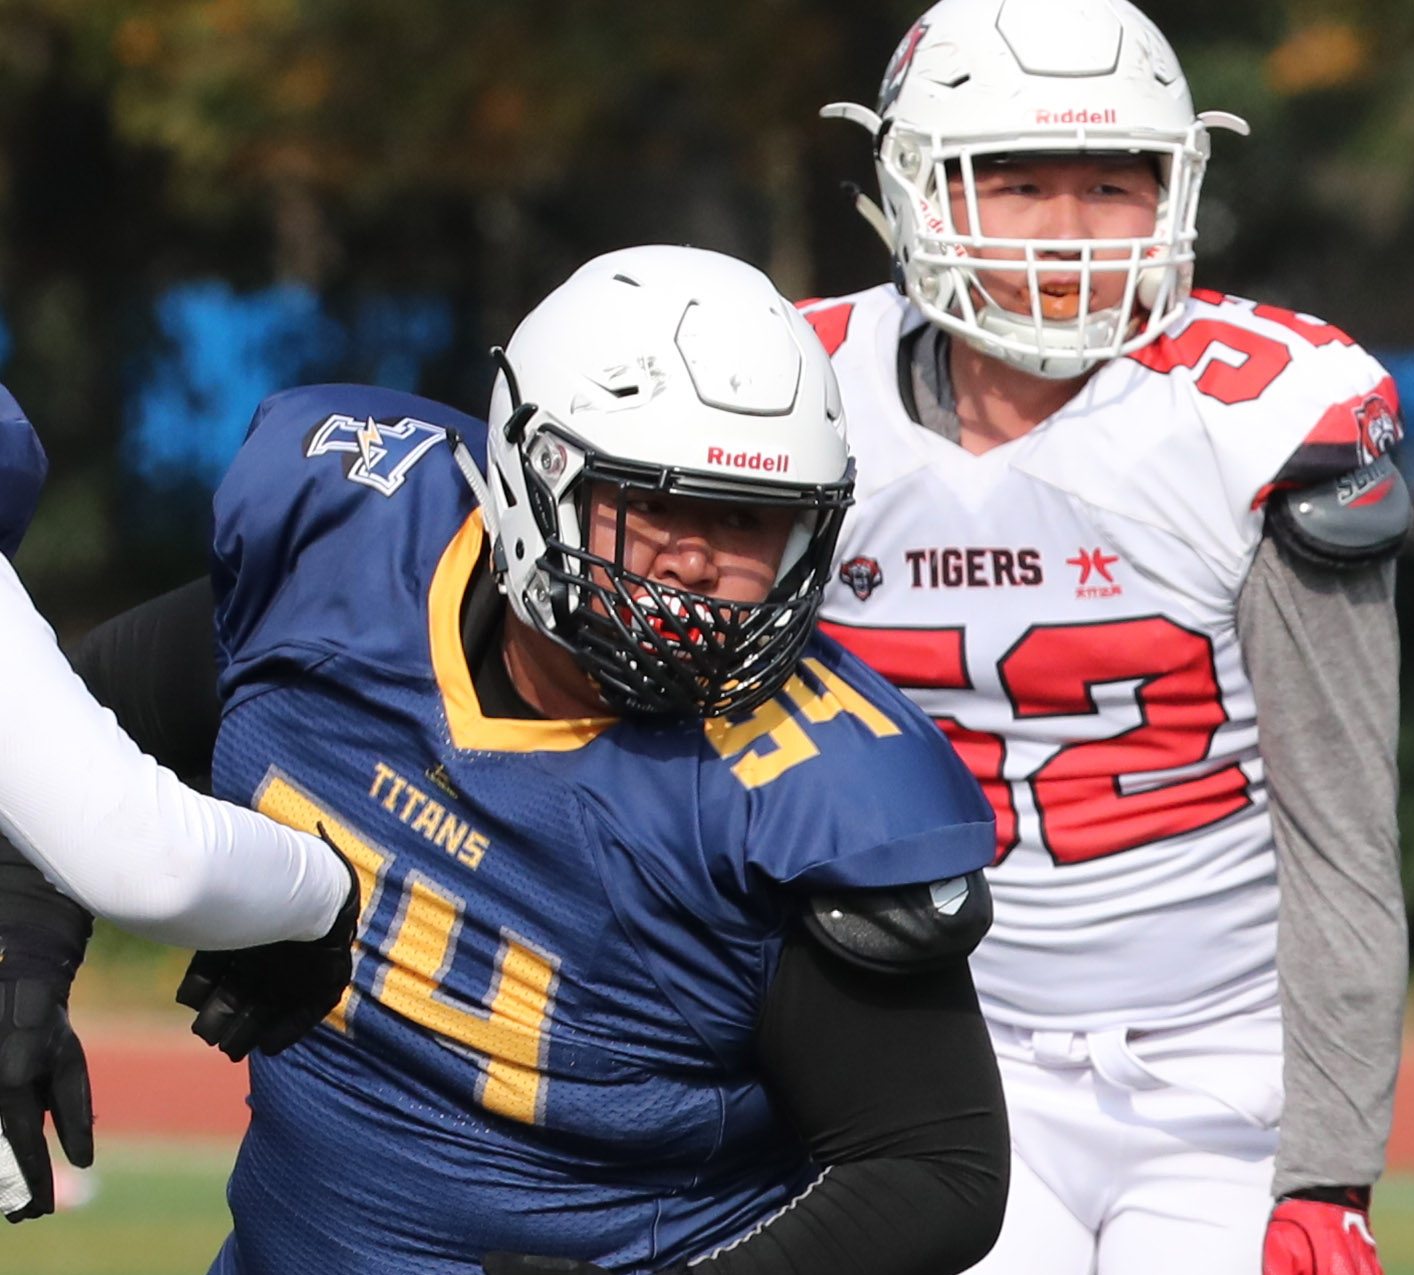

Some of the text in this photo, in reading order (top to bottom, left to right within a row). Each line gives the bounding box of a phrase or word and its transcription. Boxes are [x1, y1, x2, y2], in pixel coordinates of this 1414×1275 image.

[1036, 108, 1117, 124] Riddell
[707, 446, 789, 472] Riddell
[905, 547, 1042, 589] TIGERS
[368, 761, 491, 872] TITANS
